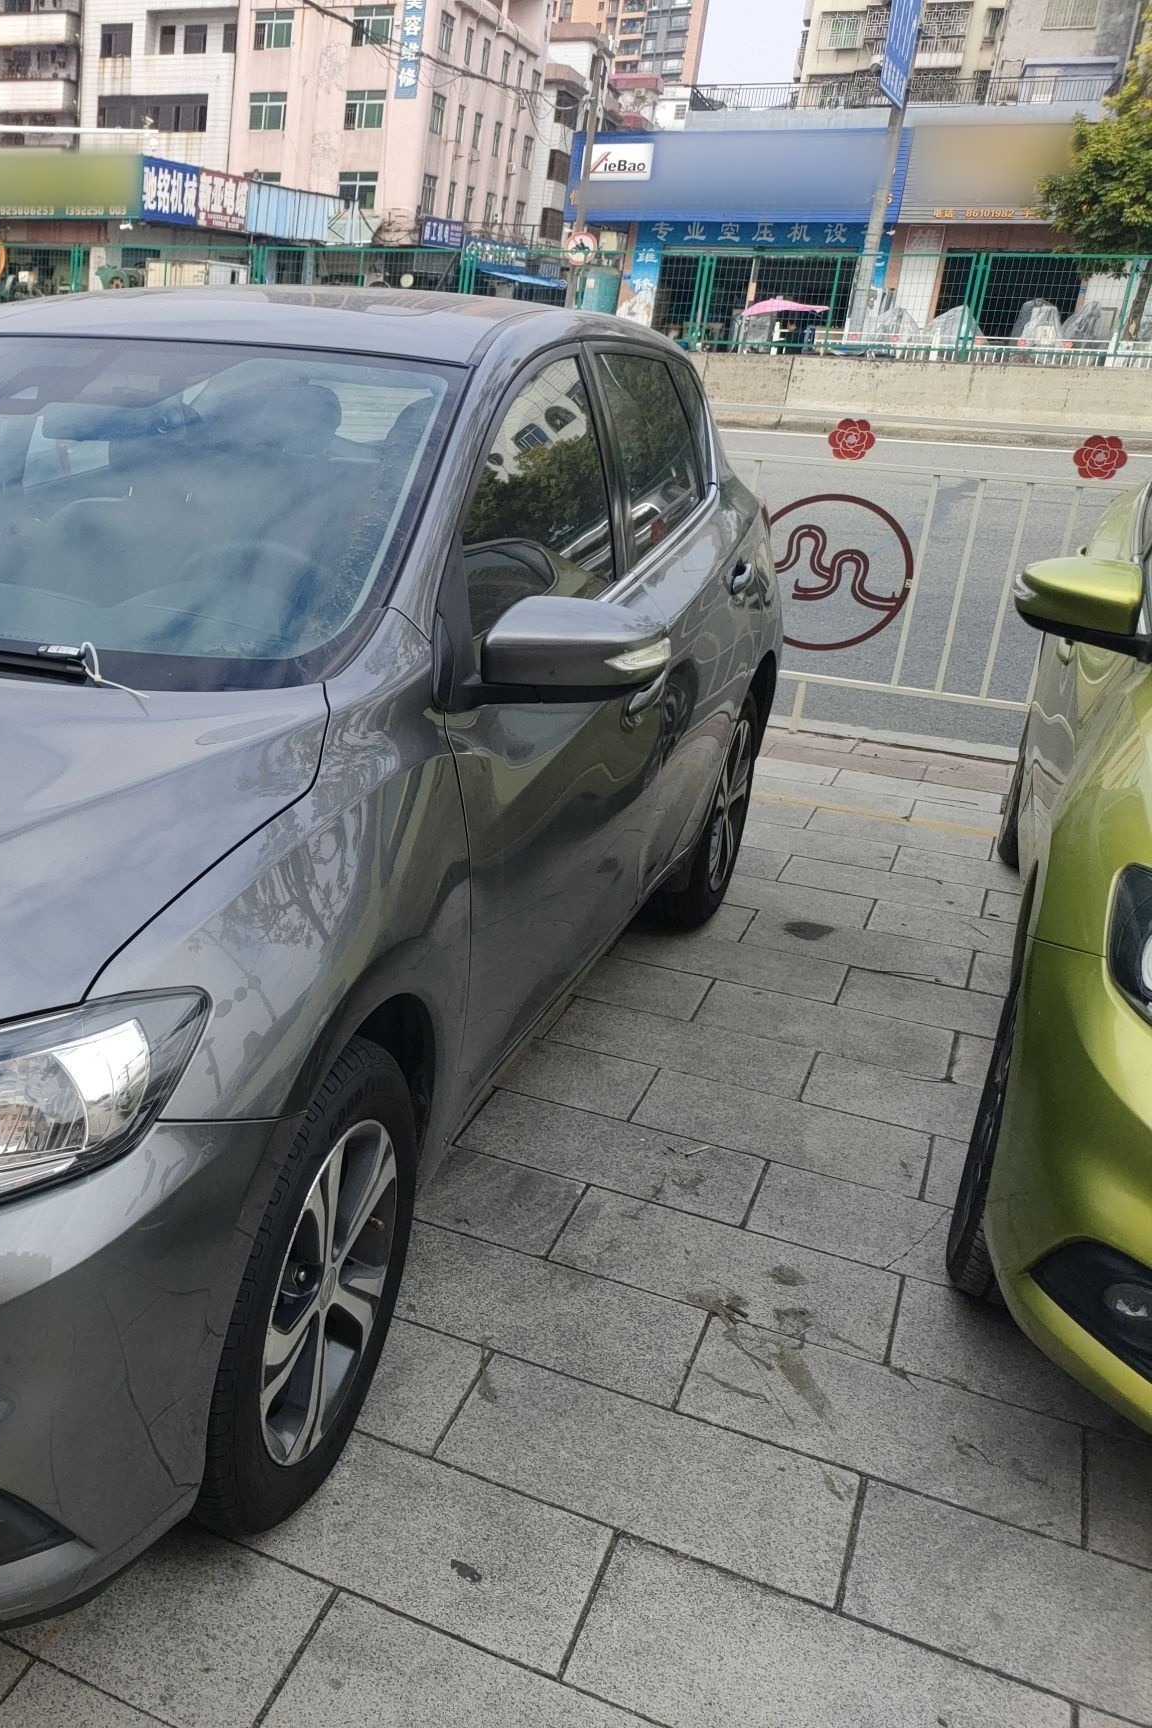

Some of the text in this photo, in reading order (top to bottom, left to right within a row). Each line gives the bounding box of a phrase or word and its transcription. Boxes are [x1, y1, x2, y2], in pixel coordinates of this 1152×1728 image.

[142, 166, 197, 218] 驰铭机械
[965, 209, 1014, 218] 86101982
[651, 222, 894, 243] 专业空压机设
